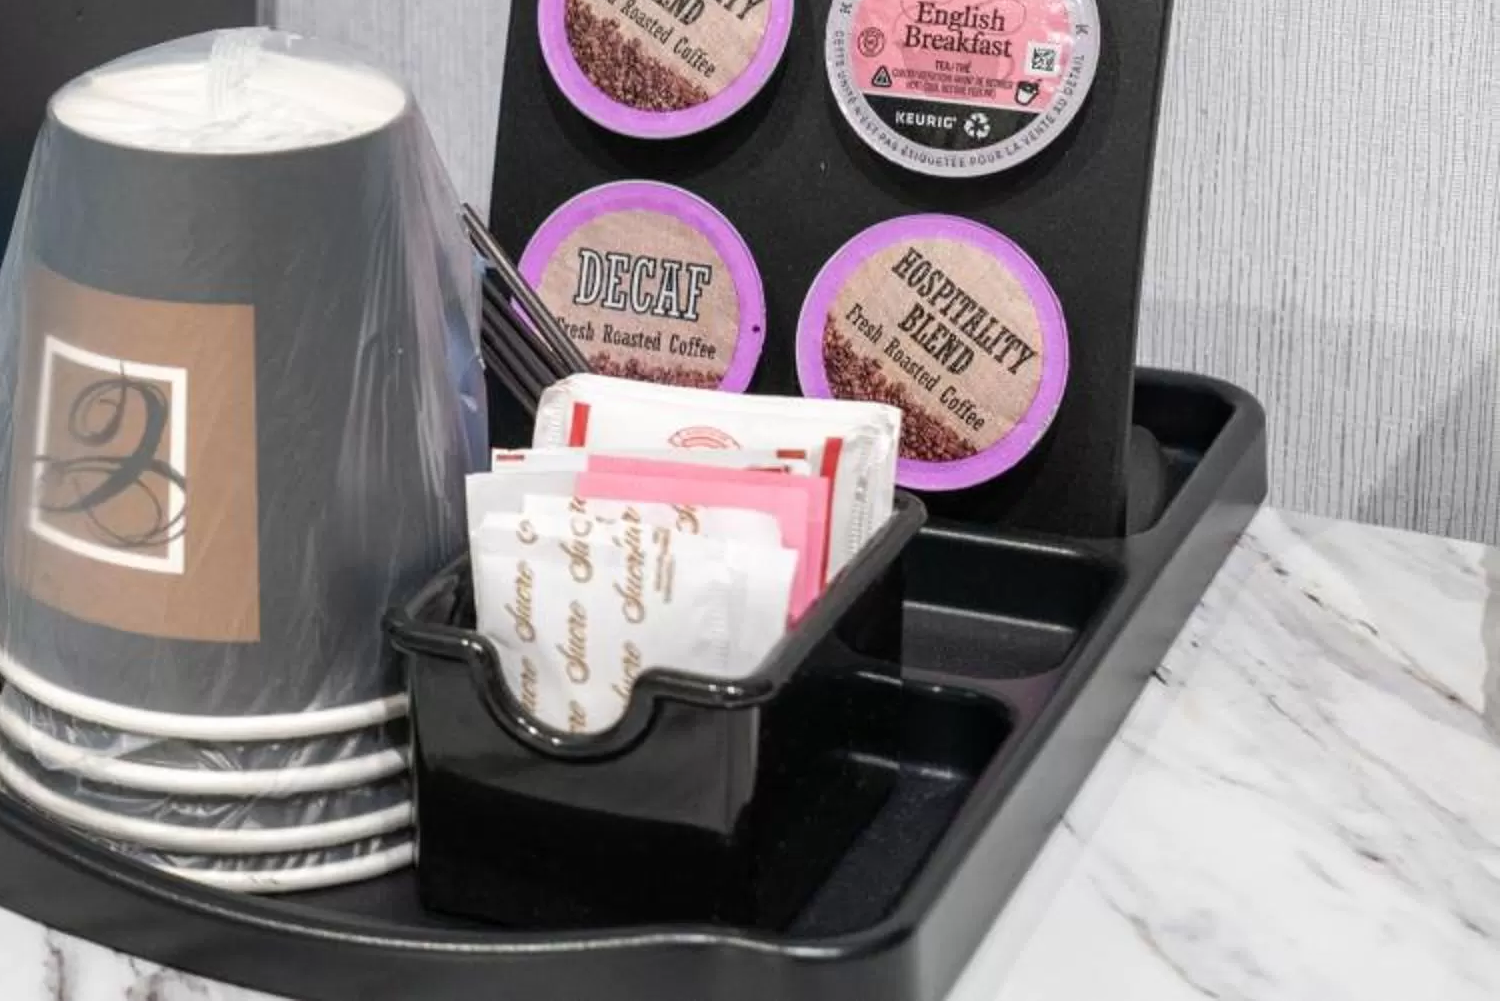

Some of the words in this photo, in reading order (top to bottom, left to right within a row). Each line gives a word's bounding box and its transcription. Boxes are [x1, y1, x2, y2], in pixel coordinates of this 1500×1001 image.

[903, 24, 1012, 57] Breakfast
[915, 1, 1005, 32] English
[673, 37, 716, 79] Coffee
[573, 247, 712, 321] DECAF
[891, 247, 1038, 375] HOSPITALITY
[603, 324, 661, 351] Roasted
[669, 334, 717, 360] Coffee
[845, 303, 883, 344] Fresh
[884, 338, 941, 392] Roasted
[940, 386, 985, 432] Coffee
[897, 302, 976, 376] BLEND
[504, 561, 535, 643] Sucre
[555, 600, 590, 685] Sucre
[521, 656, 537, 716] ucre
